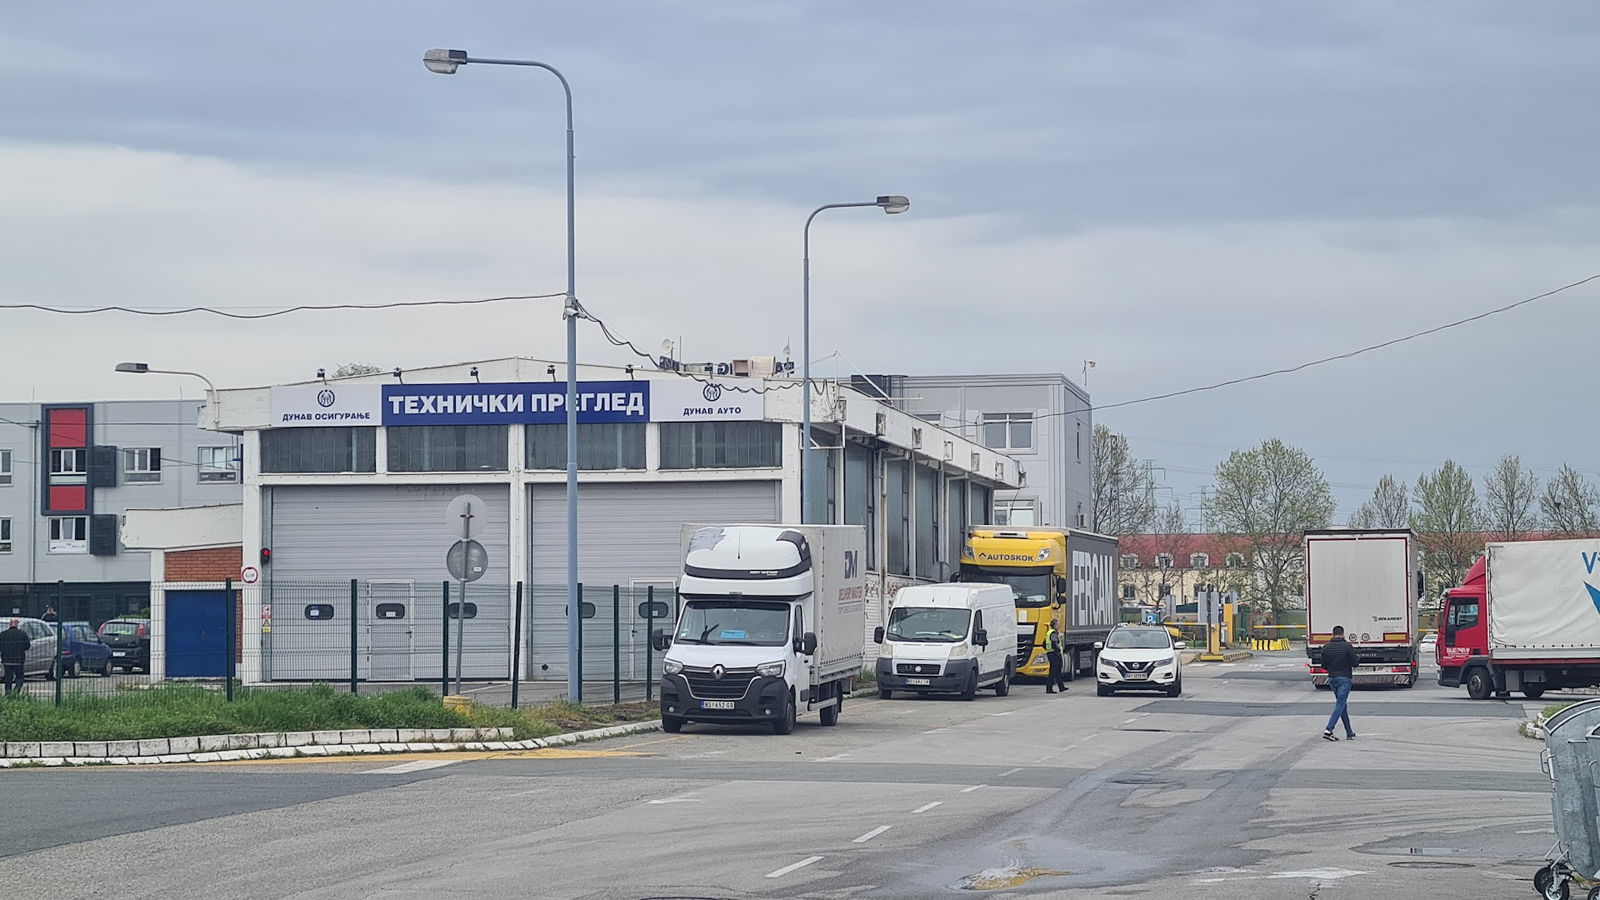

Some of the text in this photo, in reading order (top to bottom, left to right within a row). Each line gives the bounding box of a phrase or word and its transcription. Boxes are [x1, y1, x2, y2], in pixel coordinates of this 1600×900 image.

[389, 394, 524, 414] ТЕХНИЧКИ
[282, 412, 370, 421] ДУНАВ ОСИГУРАЊЕ
[683, 408, 713, 416] ДУНАВ
[987, 554, 1034, 562] AUTOSKOK
[1582, 552, 1600, 574] V
[1072, 550, 1113, 626] FERCAM
